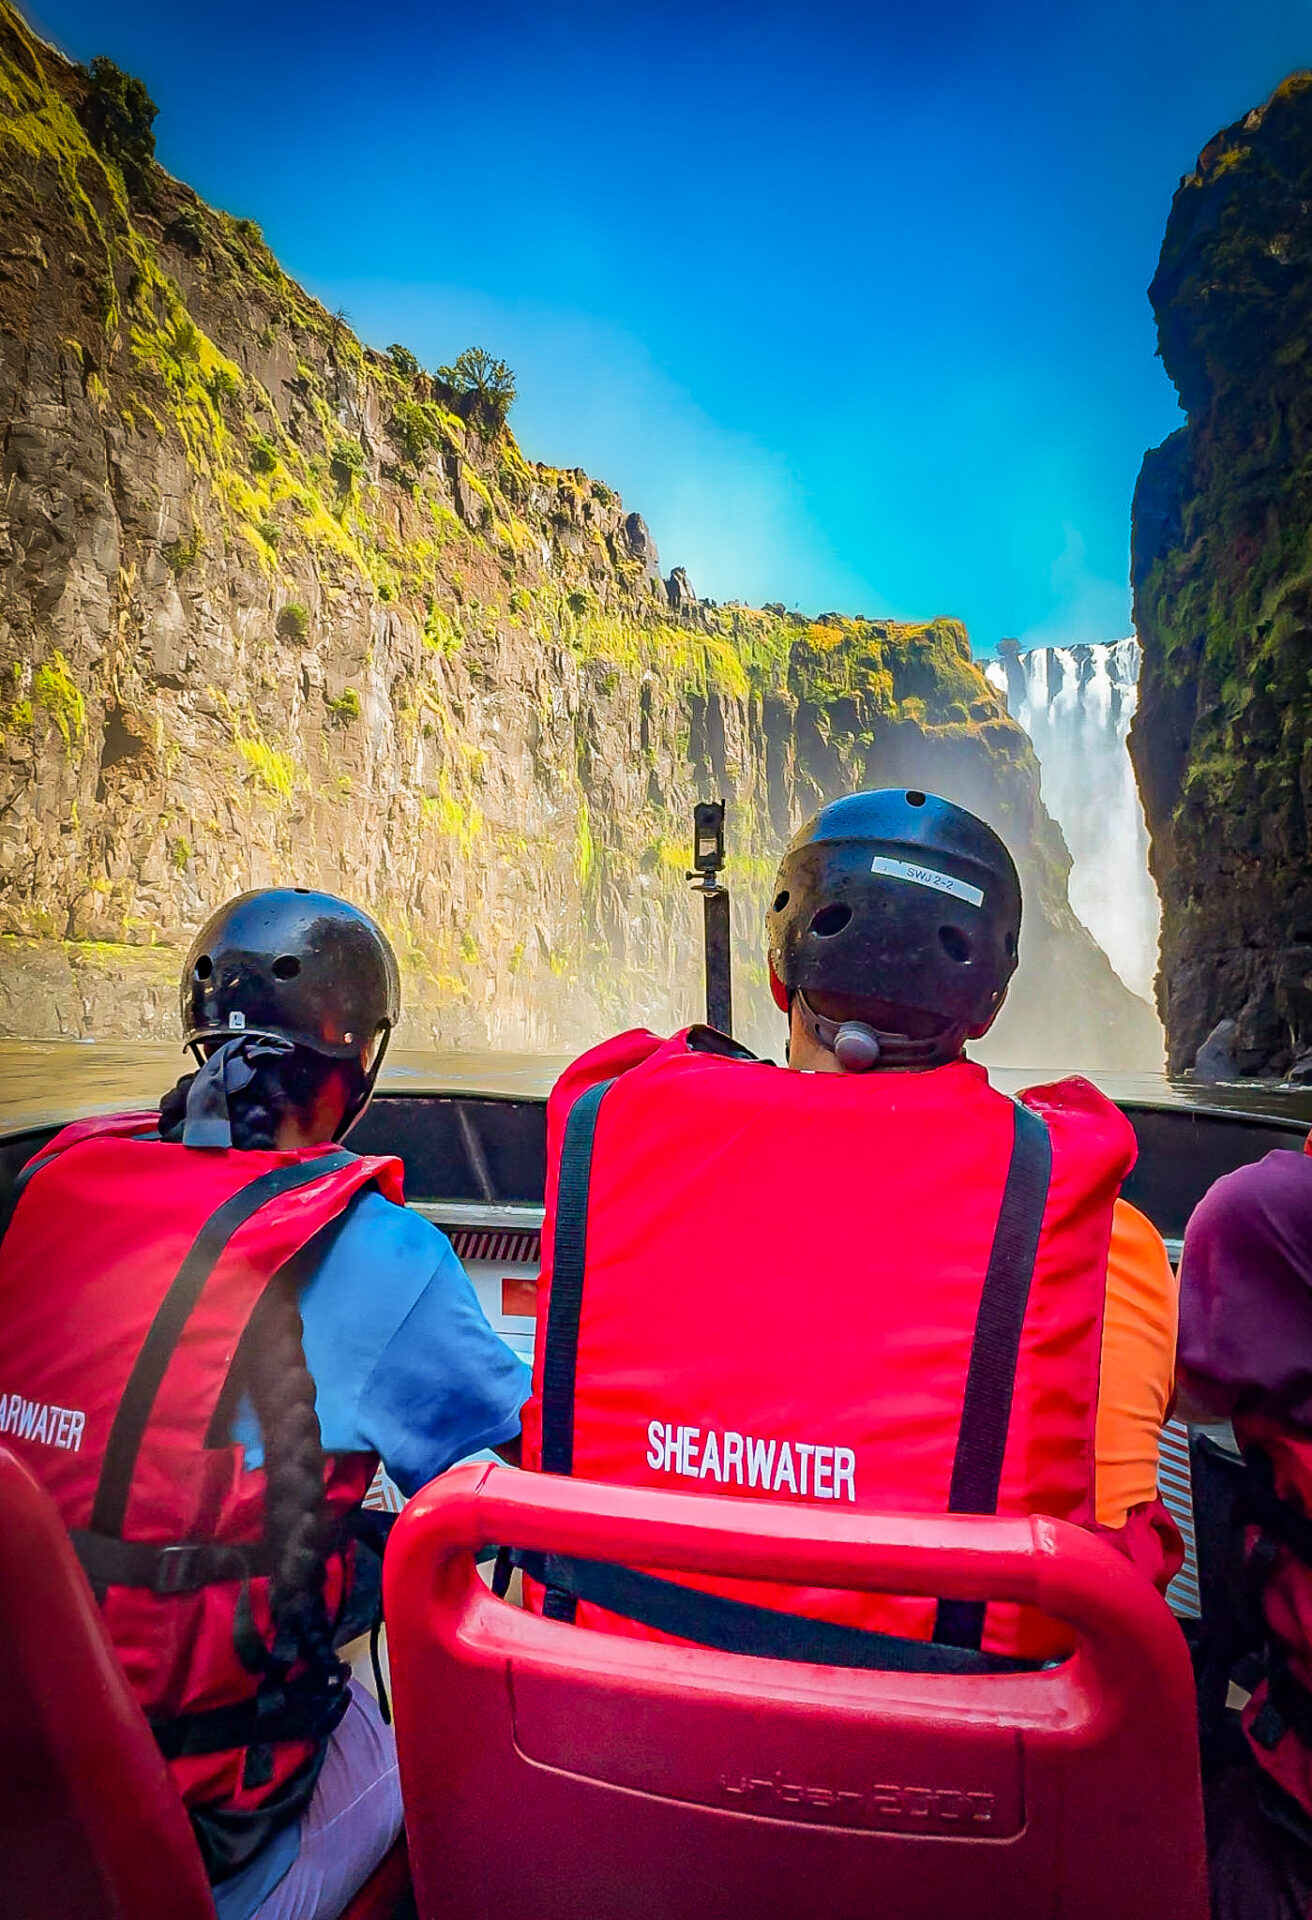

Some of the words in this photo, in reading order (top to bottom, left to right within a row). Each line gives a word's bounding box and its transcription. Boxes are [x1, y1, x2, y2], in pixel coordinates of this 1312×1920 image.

[906, 867, 932, 882] SWJ
[934, 875, 954, 890] 2-2
[0, 1393, 86, 1453] ARWATER
[646, 1419, 857, 1502] SHEARWATER
